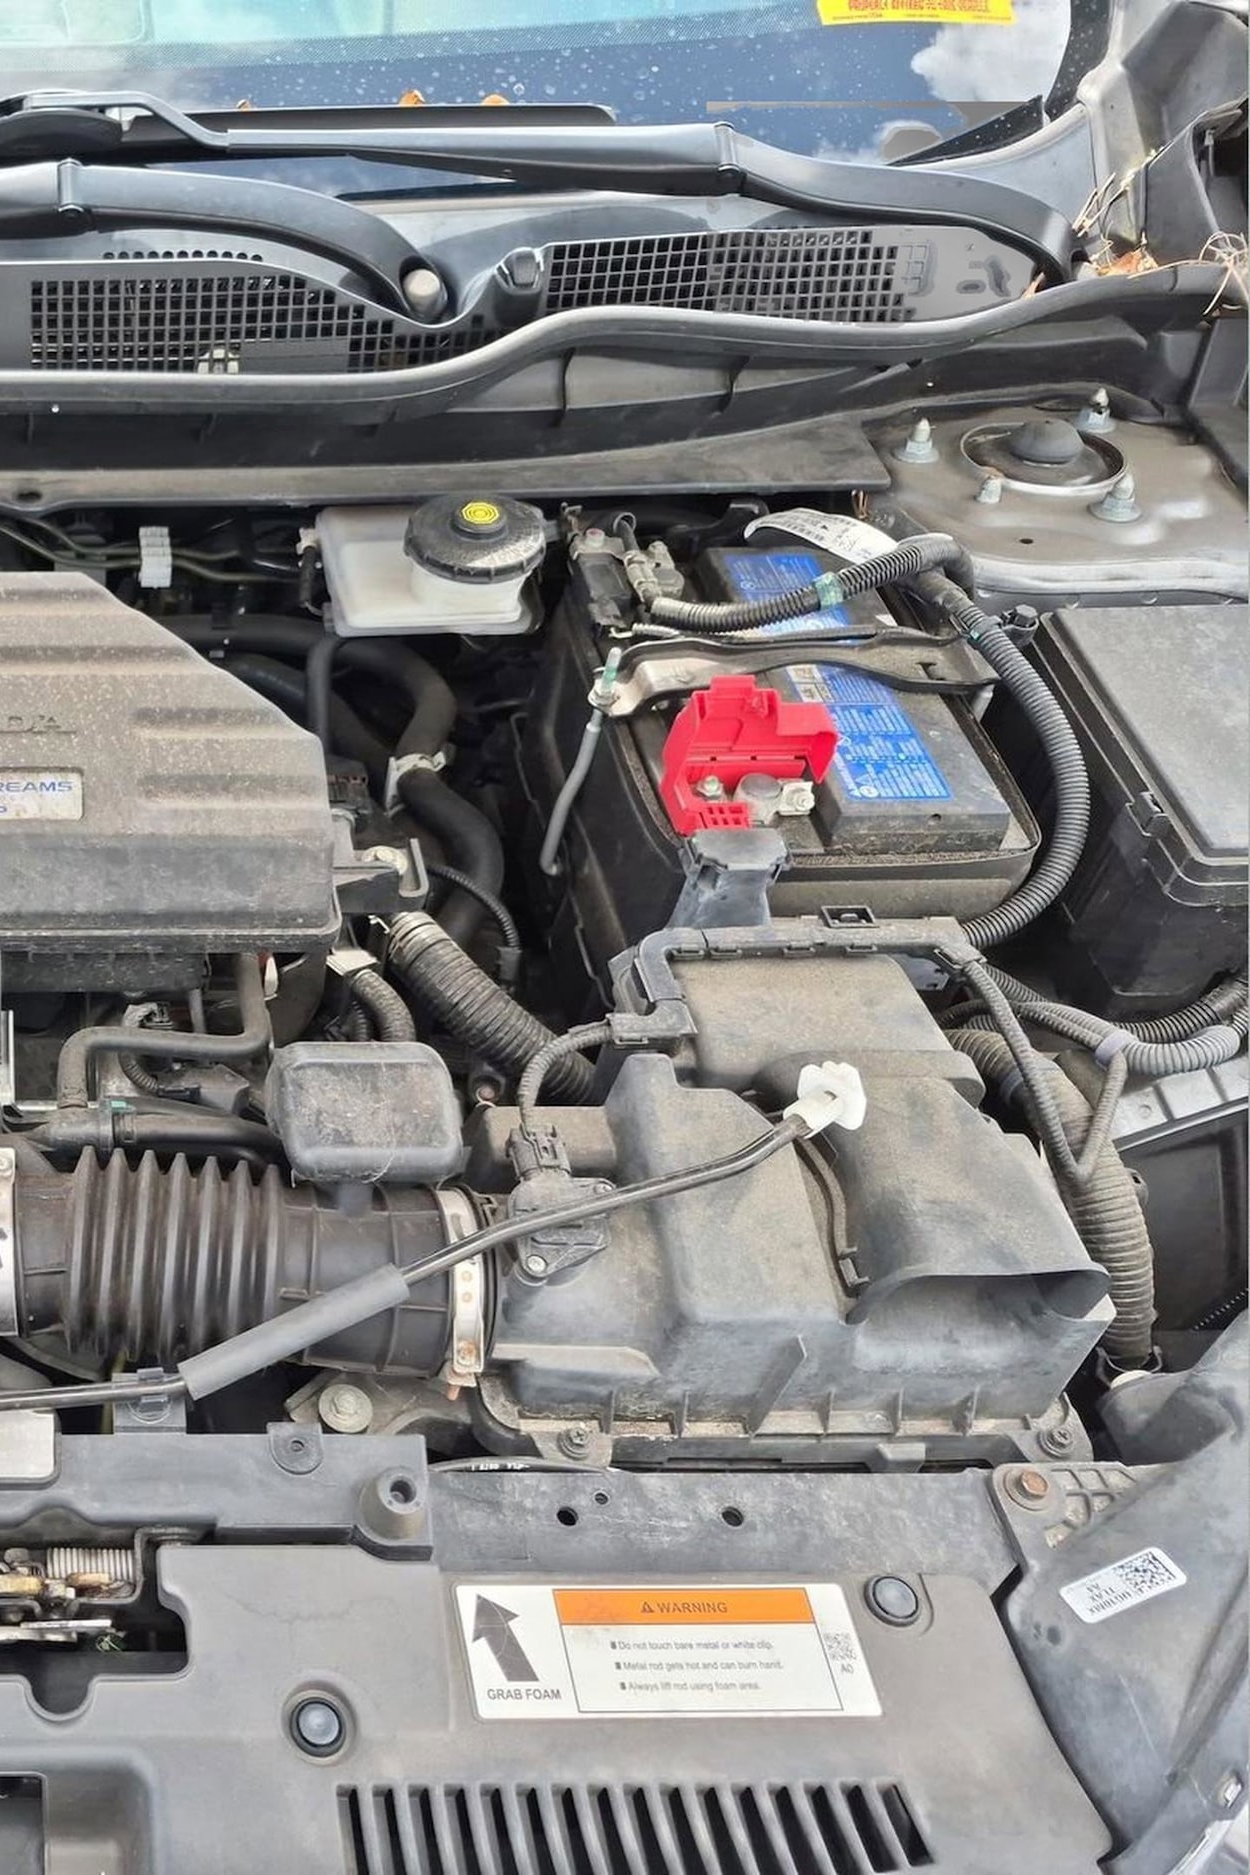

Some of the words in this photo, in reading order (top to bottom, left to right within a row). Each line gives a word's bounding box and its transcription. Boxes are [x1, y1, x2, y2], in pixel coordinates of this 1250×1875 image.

[657, 1602, 728, 1614] WARNING
[618, 1641, 631, 1650] Do
[633, 1641, 647, 1650] not
[649, 1641, 672, 1650] touch
[674, 1641, 694, 1650] bare
[696, 1641, 719, 1650] metal
[721, 1642, 730, 1650] or
[732, 1640, 755, 1650] white
[623, 1661, 647, 1670] Metal
[649, 1661, 664, 1670] rod
[666, 1662, 684, 1673] gets
[686, 1661, 700, 1670] hot
[702, 1661, 718, 1670] and
[720, 1662, 736, 1670] can
[738, 1661, 757, 1670] burn
[629, 1681, 659, 1692] Always
[673, 1681, 688, 1690] rod
[690, 1681, 713, 1692] using
[714, 1681, 736, 1690] foam
[487, 1688, 523, 1700] GRAB
[526, 1689, 562, 1700] FOAM
